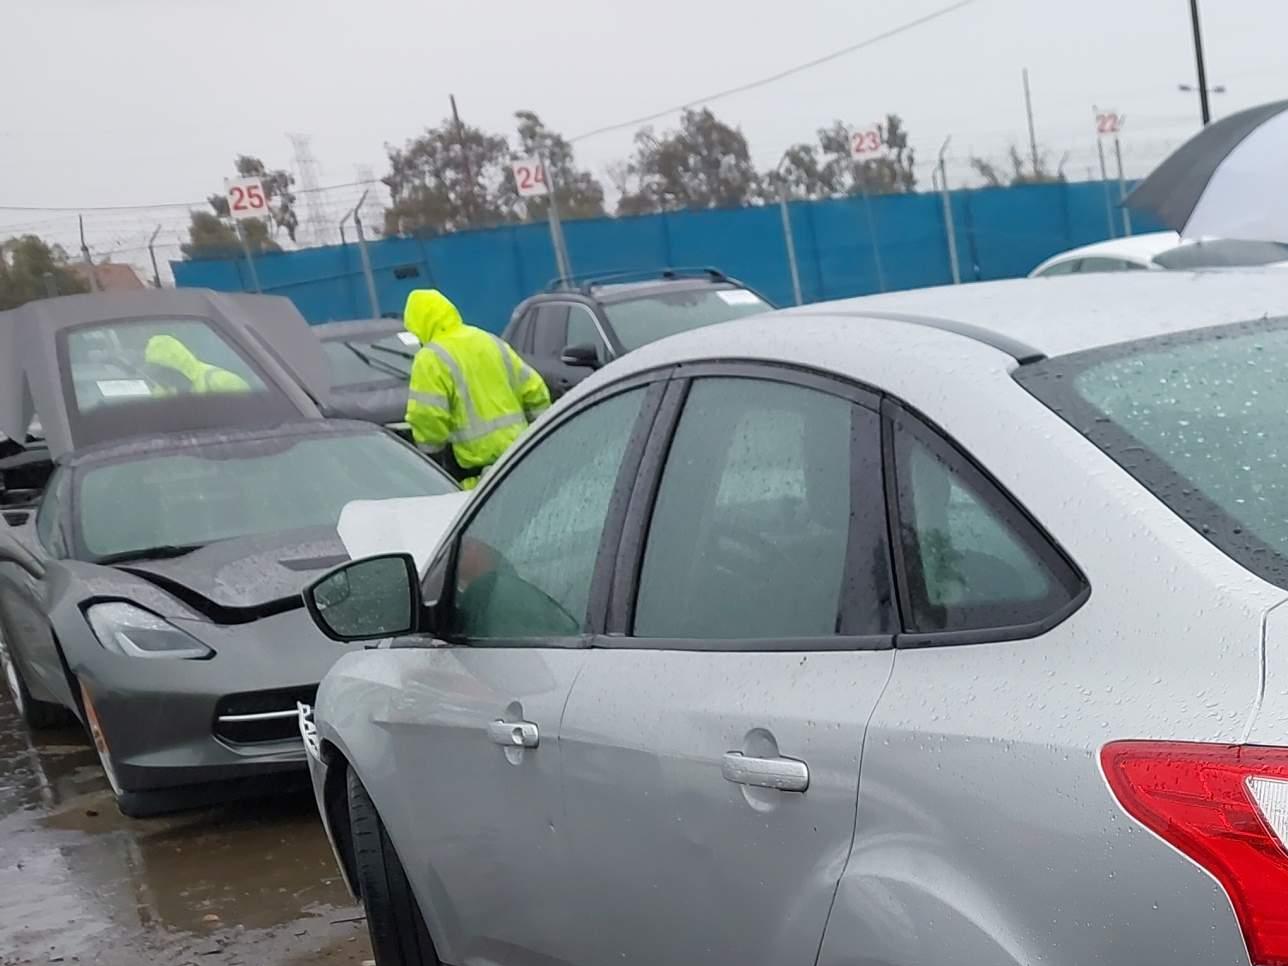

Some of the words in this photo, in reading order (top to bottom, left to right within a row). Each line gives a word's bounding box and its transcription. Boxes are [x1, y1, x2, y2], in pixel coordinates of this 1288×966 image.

[852, 131, 880, 153] 23
[517, 164, 545, 189] 24
[229, 185, 264, 211] 25
